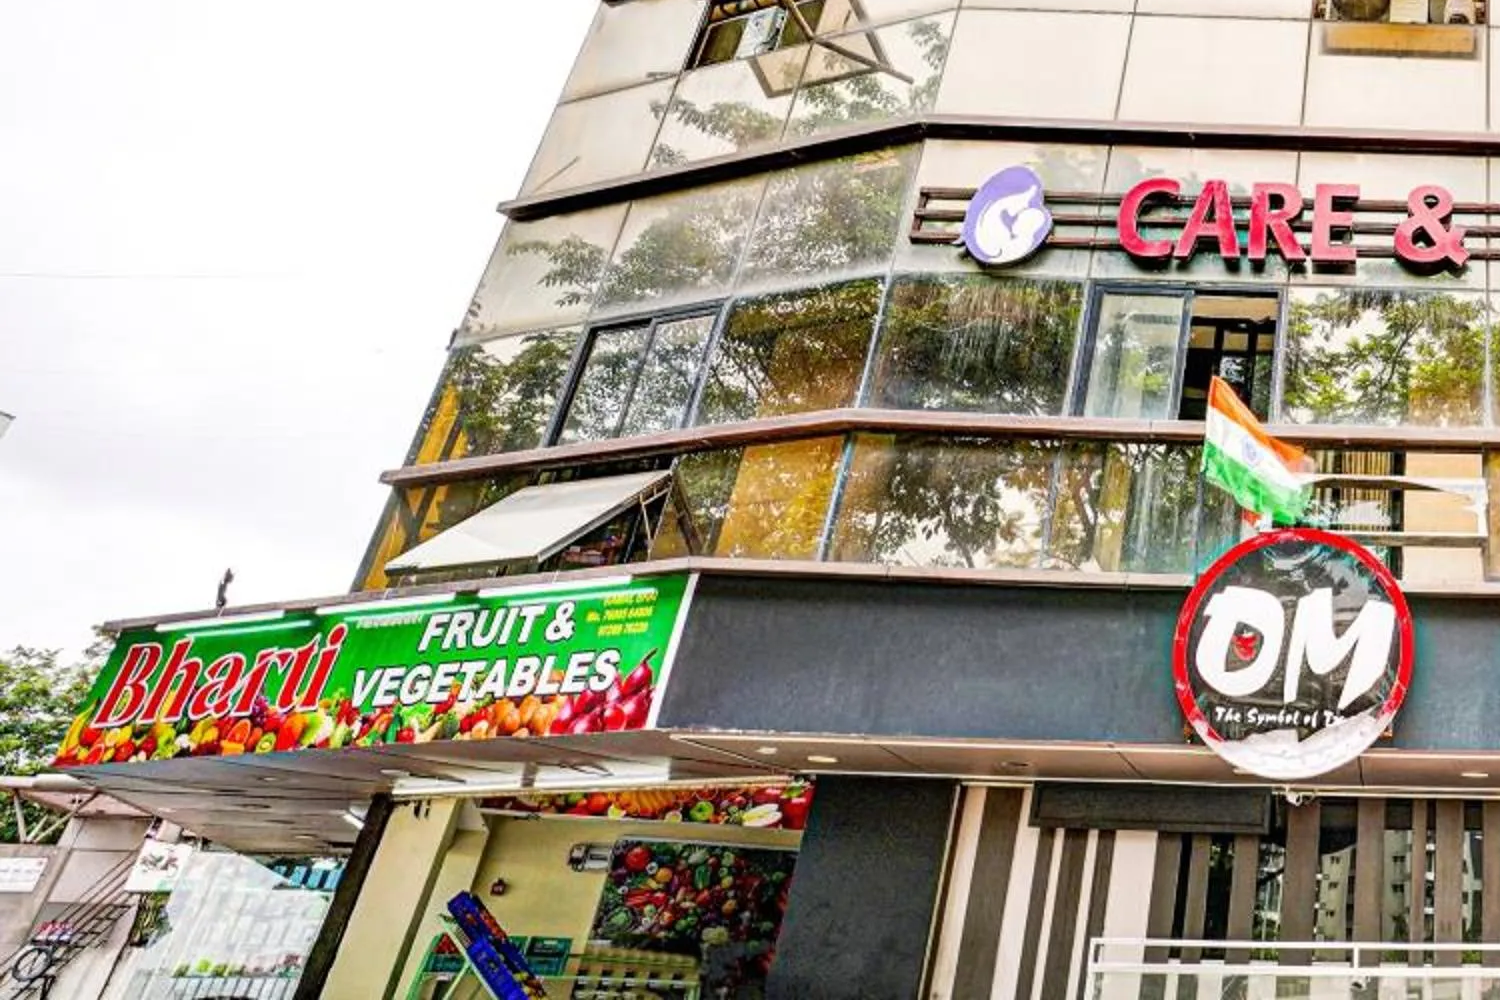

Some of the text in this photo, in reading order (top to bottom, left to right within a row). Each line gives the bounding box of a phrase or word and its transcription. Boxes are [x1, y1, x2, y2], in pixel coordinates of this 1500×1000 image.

[1117, 178, 1362, 265] CARE
[1394, 185, 1468, 270] &
[417, 602, 543, 653] FRUIT
[545, 600, 575, 641] &
[93, 623, 347, 728] Bharti
[351, 648, 621, 708] VEGETABLES
[1215, 706, 1241, 724] The
[1247, 706, 1299, 727] Symbol
[1303, 710, 1317, 729] of
